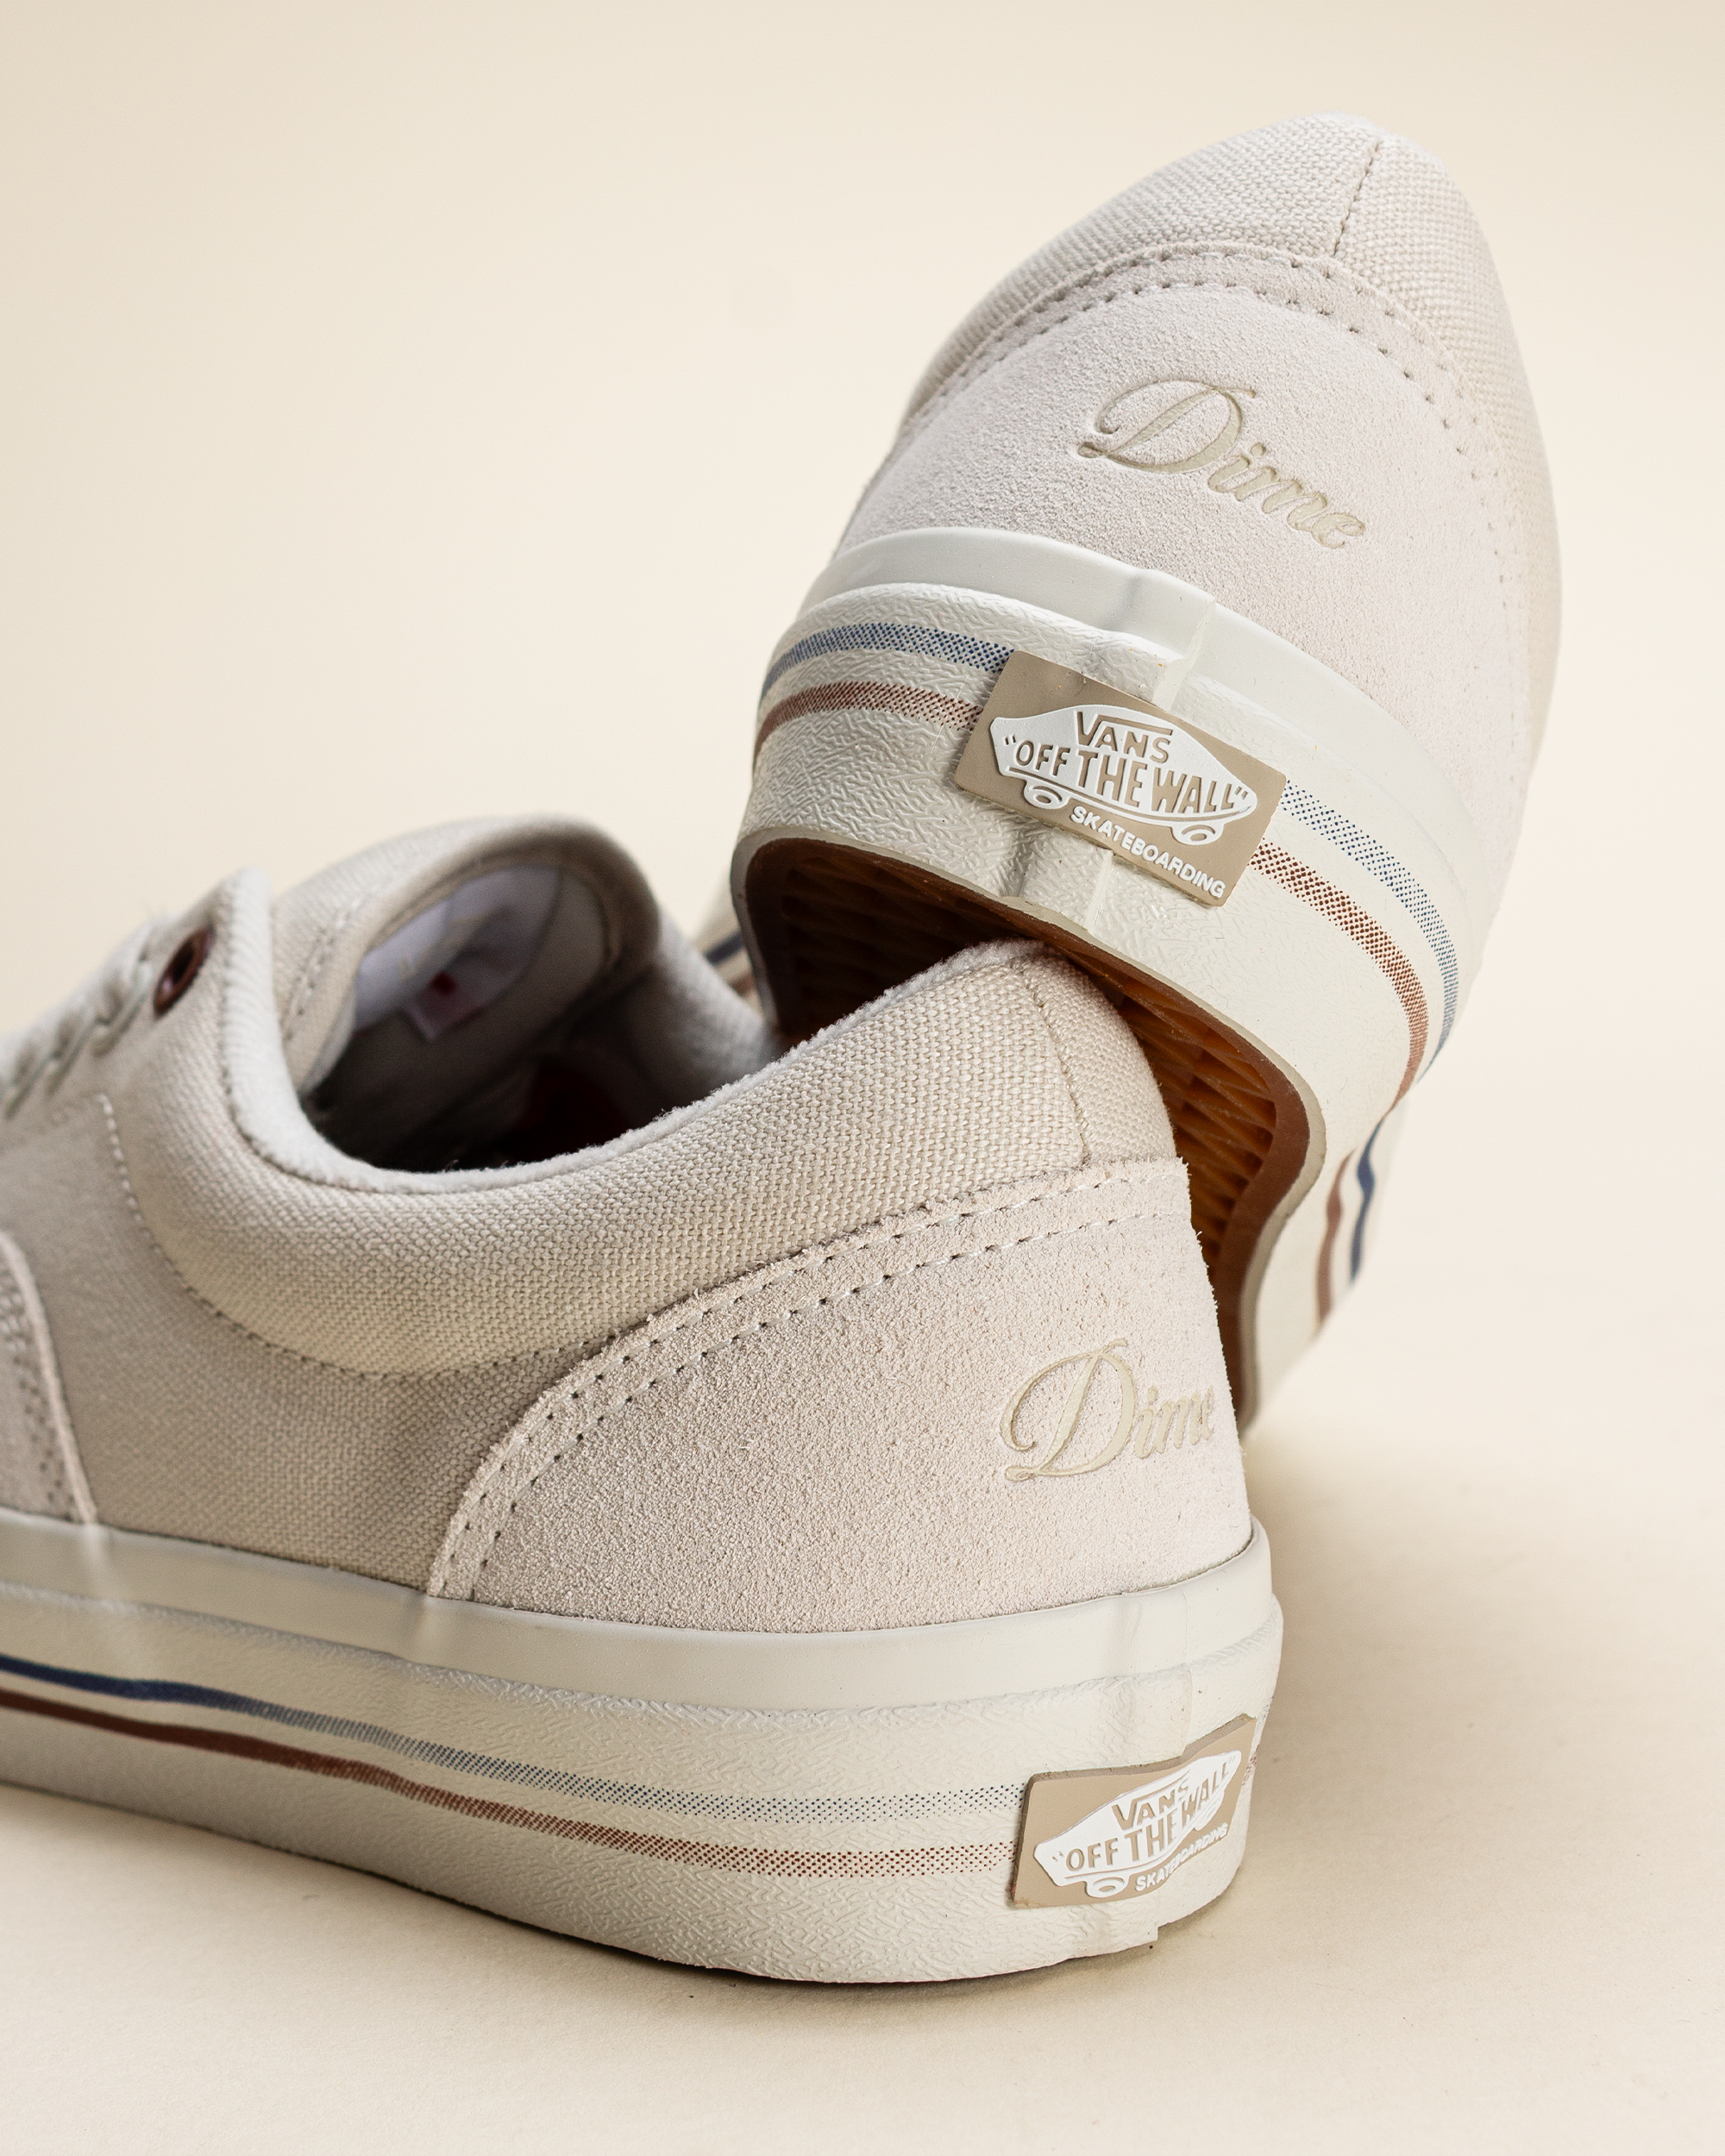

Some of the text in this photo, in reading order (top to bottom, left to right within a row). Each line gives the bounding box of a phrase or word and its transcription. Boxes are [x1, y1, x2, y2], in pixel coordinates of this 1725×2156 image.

[1078, 377, 1365, 548] Dime
[1075, 710, 1174, 764] VANS
[1077, 749, 1147, 808] THE
[1070, 805, 1226, 899] SKATEBOARDING
[1000, 1338, 1214, 1482] Dime
[1111, 1770, 1191, 1831] VANS
[1124, 1809, 1177, 1863] THE
[1134, 1821, 1229, 1892] SKATEBOARDING
